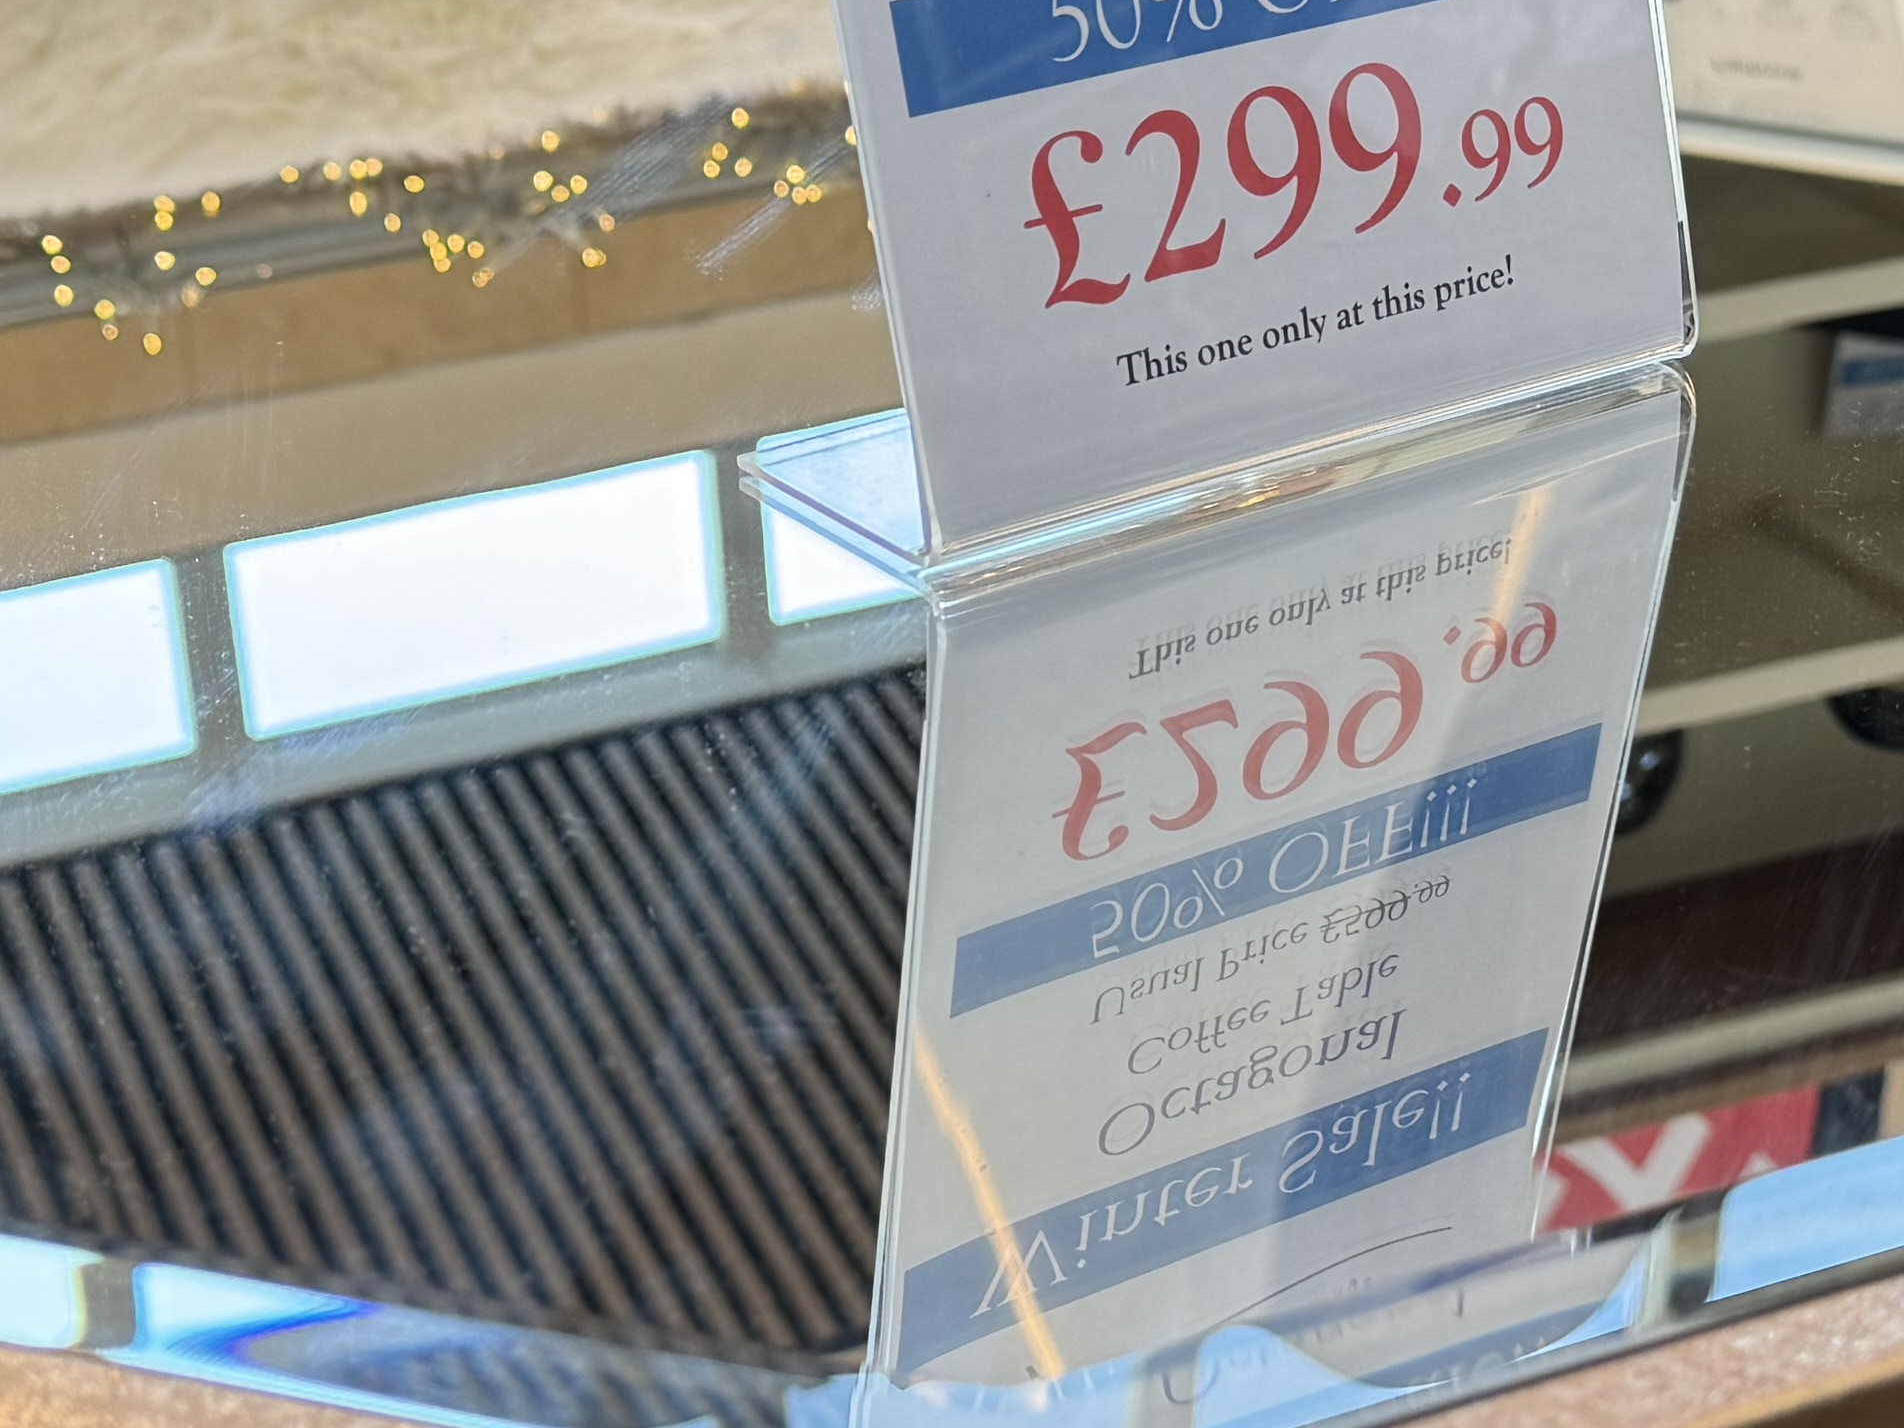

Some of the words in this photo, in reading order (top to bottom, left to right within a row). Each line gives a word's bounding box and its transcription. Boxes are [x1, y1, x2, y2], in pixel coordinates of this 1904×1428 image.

[1023, 62, 1564, 309] £299.99
[1116, 346, 1189, 386] This
[1197, 334, 1253, 367] one
[1262, 307, 1327, 350] only
[1336, 301, 1364, 331] at
[1372, 283, 1426, 322] this
[1434, 254, 1515, 312] price!
